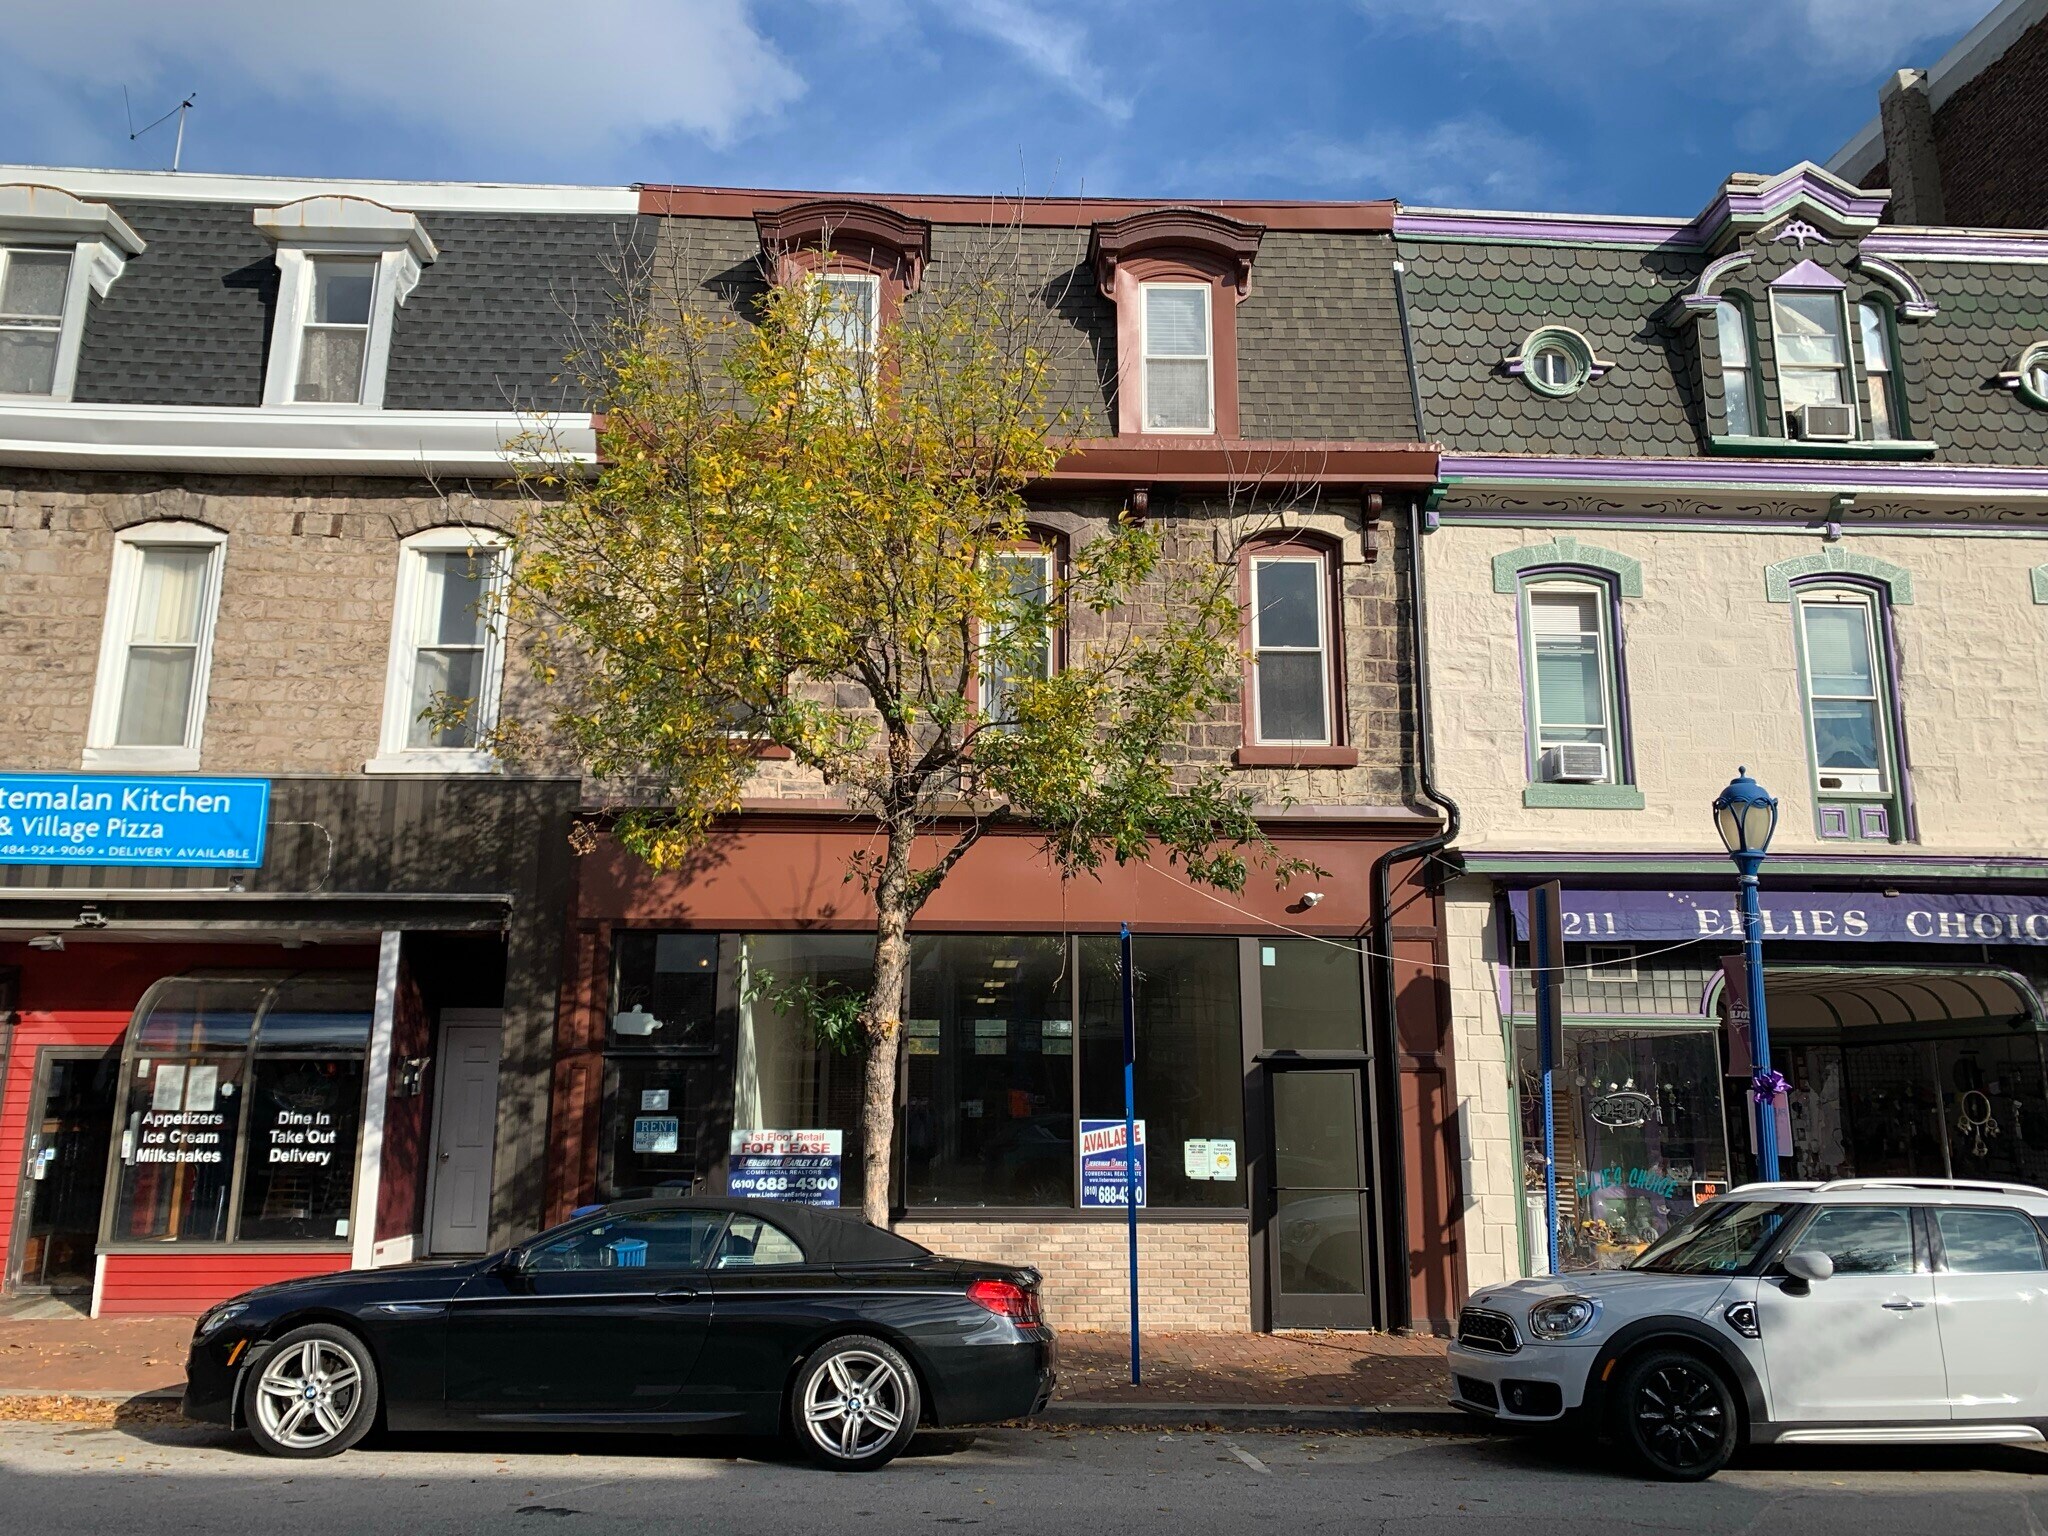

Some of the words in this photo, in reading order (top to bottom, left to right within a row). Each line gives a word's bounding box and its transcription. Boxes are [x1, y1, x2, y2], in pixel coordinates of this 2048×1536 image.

[121, 787, 230, 812] Kitchen
[21, 815, 98, 843] Village
[106, 818, 163, 838] Pizza
[0, 845, 94, 855] 484-924-9069
[108, 846, 171, 857] DELIVERY
[177, 848, 249, 858] AVAILABLE
[1562, 912, 1616, 935] 211
[142, 1112, 223, 1126] Appetizers
[278, 1112, 311, 1125] Dine
[316, 1112, 330, 1125] In
[641, 1121, 676, 1132] RENT
[142, 1131, 166, 1144] Ice
[169, 1131, 219, 1144] Cream
[269, 1131, 303, 1144] Take
[307, 1131, 336, 1144] Out
[749, 1133, 764, 1141] 1st
[767, 1132, 793, 1141] Floor
[796, 1132, 825, 1141] Retail
[1084, 1124, 1141, 1153] AVAILABE
[741, 1143, 775, 1154] FOR
[780, 1143, 830, 1154] LEASE
[136, 1149, 221, 1163] Milkshakes
[269, 1149, 331, 1165] Delivery
[731, 1179, 755, 1190] (610)
[755, 1177, 838, 1190] 688-4300
[1704, 1184, 1716, 1194] NO
[1098, 1186, 1143, 1204] 688-430
